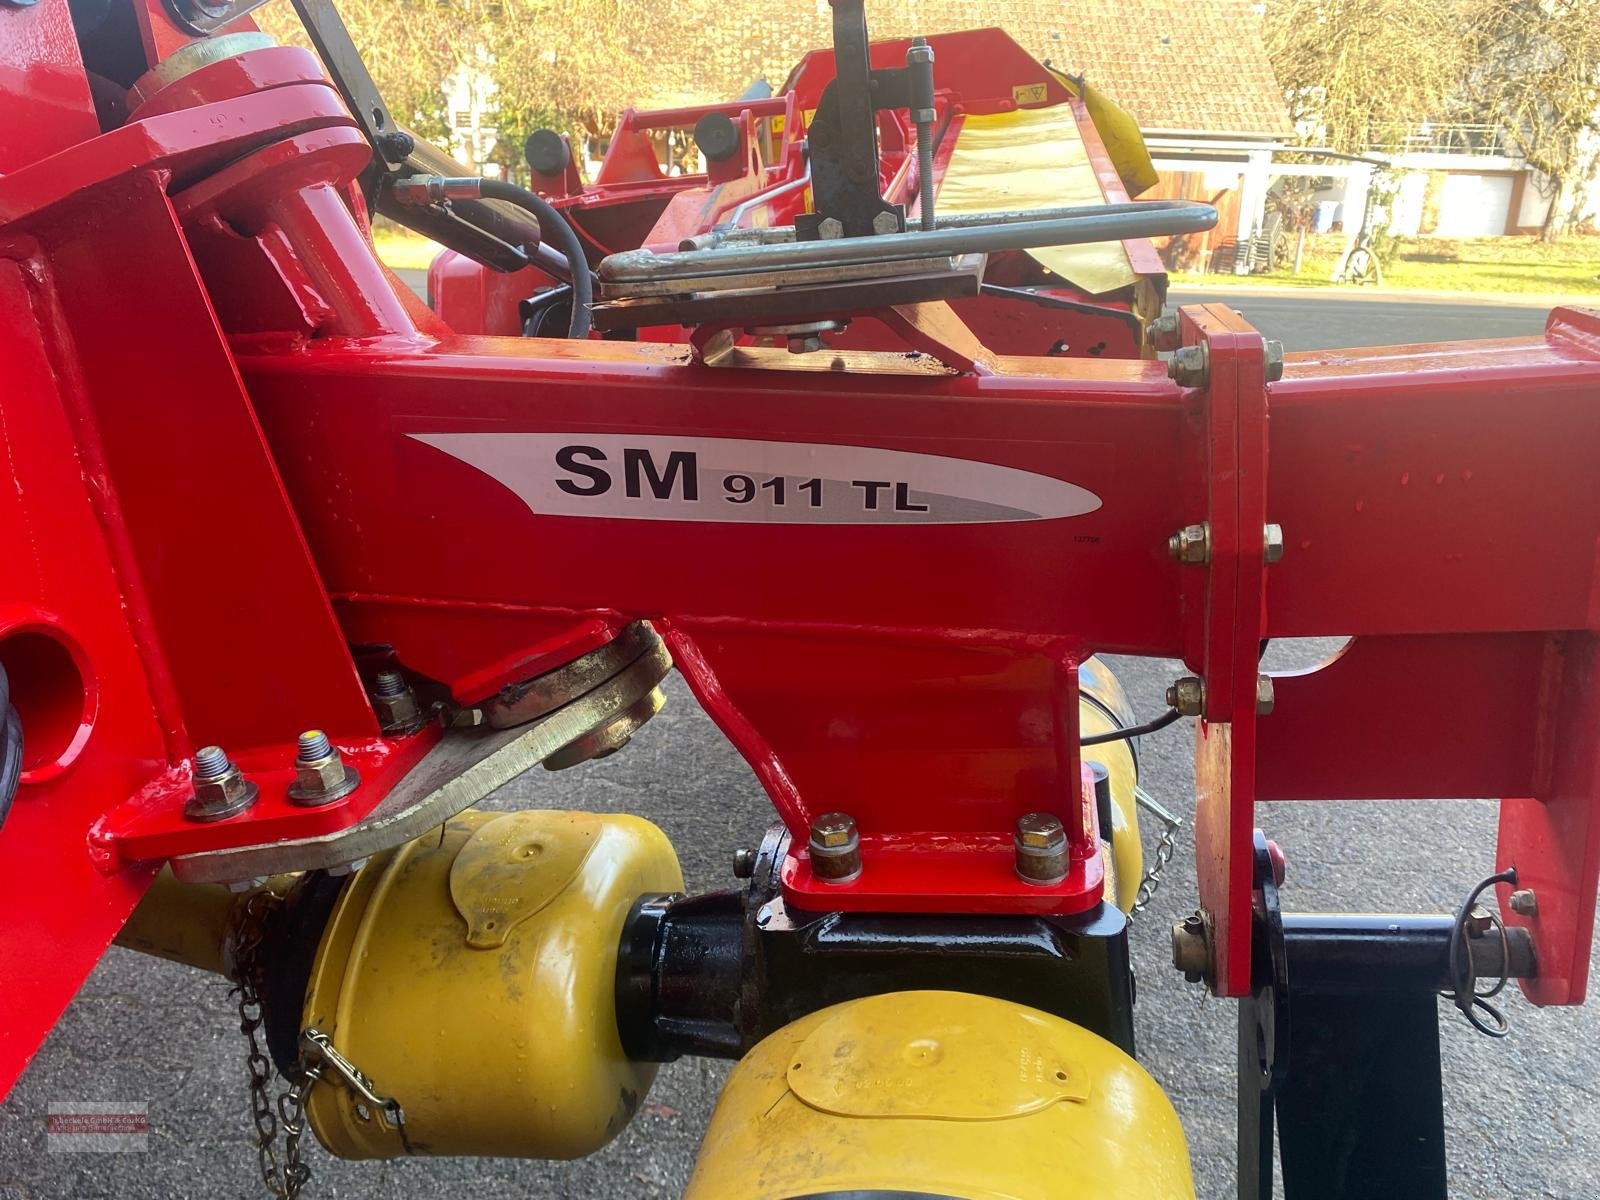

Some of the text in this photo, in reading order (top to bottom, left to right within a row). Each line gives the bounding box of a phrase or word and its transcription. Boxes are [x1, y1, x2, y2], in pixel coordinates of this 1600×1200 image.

[555, 445, 928, 512] SM 911 TL
